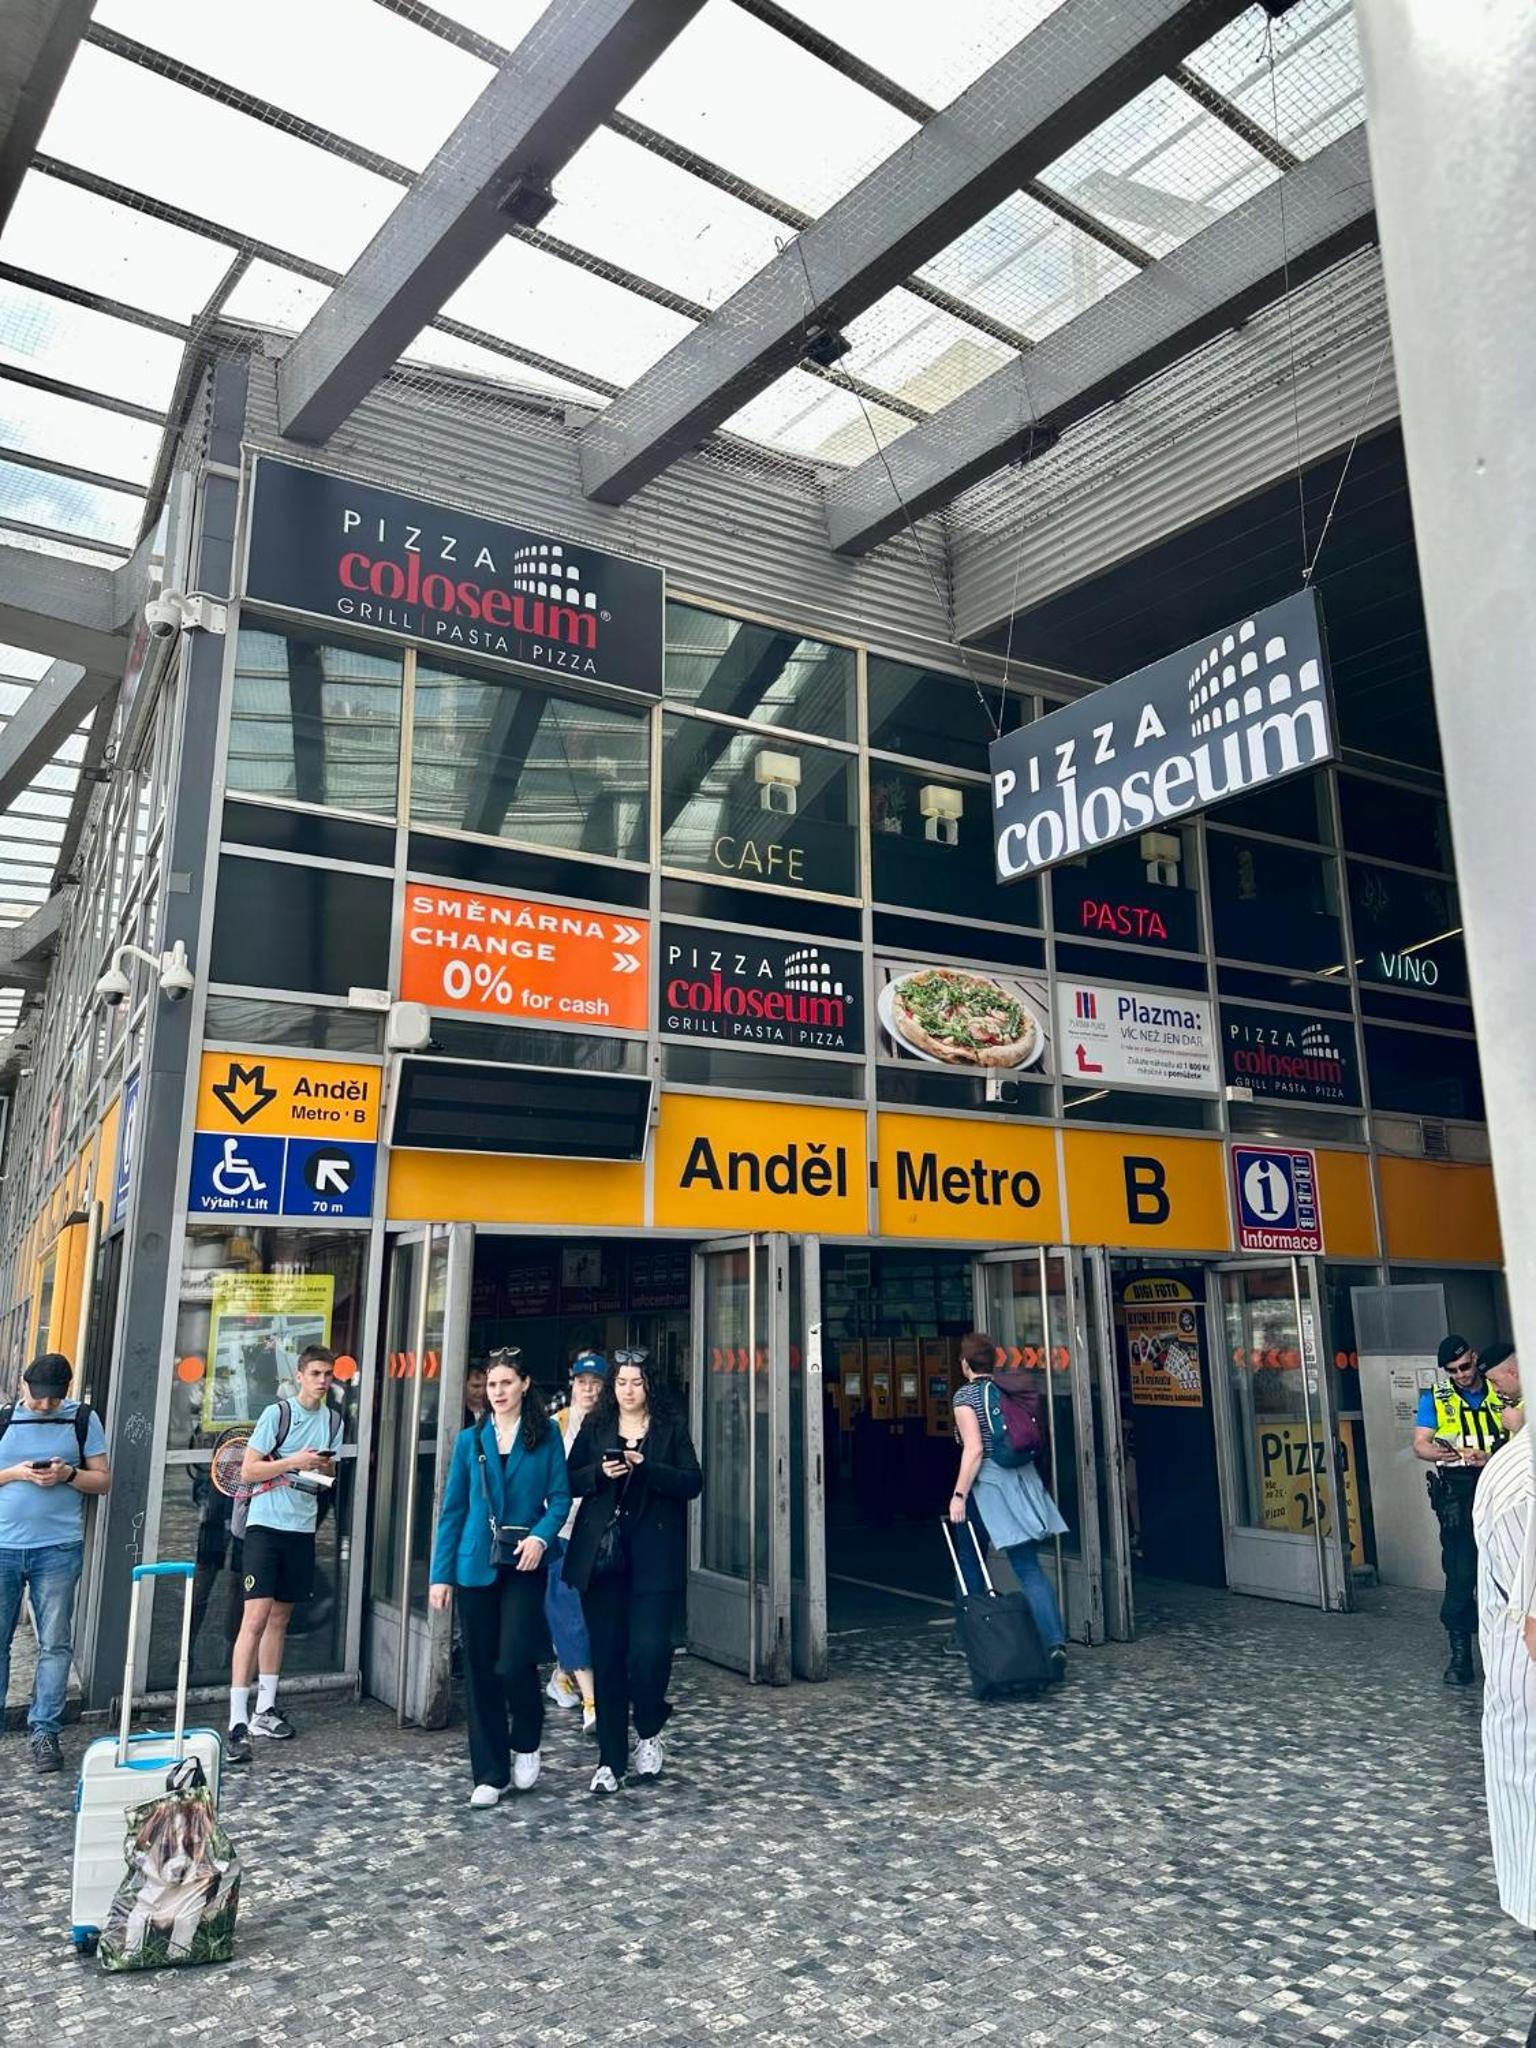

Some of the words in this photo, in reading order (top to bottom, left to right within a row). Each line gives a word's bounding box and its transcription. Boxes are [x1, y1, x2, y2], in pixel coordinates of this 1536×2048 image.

[343, 509, 496, 573] PIZZA
[337, 597, 412, 629] GRILL
[436, 620, 508, 653] PASTA
[533, 644, 597, 674] PIZZA
[994, 703, 1167, 809] PIZZA
[997, 699, 1330, 878] coloseum
[714, 836, 805, 881] CAFE
[412, 896, 605, 940] SMĚNÁRNA
[1081, 900, 1168, 940] PASTA
[410, 927, 556, 962] CHANGE
[669, 945, 774, 979] PIZZA
[442, 959, 513, 1005] 0%
[521, 988, 554, 1010] for
[559, 997, 610, 1016] cash
[1117, 996, 1202, 1031] Plazma:
[667, 1015, 719, 1033] GRILL
[733, 1023, 784, 1040] PASTA
[800, 1029, 846, 1047] PIZZA
[1120, 1026, 1138, 1040] VÍC
[1140, 1029, 1161, 1043] NEŽ
[1162, 1032, 1180, 1045] JEN
[1230, 1025, 1296, 1048] PIZZA
[293, 1077, 368, 1101] Anděl
[1235, 1077, 1267, 1090] GRILL
[1274, 1081, 1306, 1093] PASTA
[1315, 1086, 1345, 1099] PIZZA
[291, 1105, 341, 1122] Metro
[354, 1110, 366, 1123] B
[679, 1136, 848, 1198] Anděl
[895, 1150, 1042, 1208] Metro
[1122, 1155, 1171, 1226] B
[201, 1196, 239, 1211] Výtah
[247, 1197, 268, 1210] Lift
[312, 1201, 328, 1213] 70
[331, 1203, 344, 1213] m
[1242, 1229, 1319, 1250] Informace
[1155, 1282, 1180, 1298] FOTO
